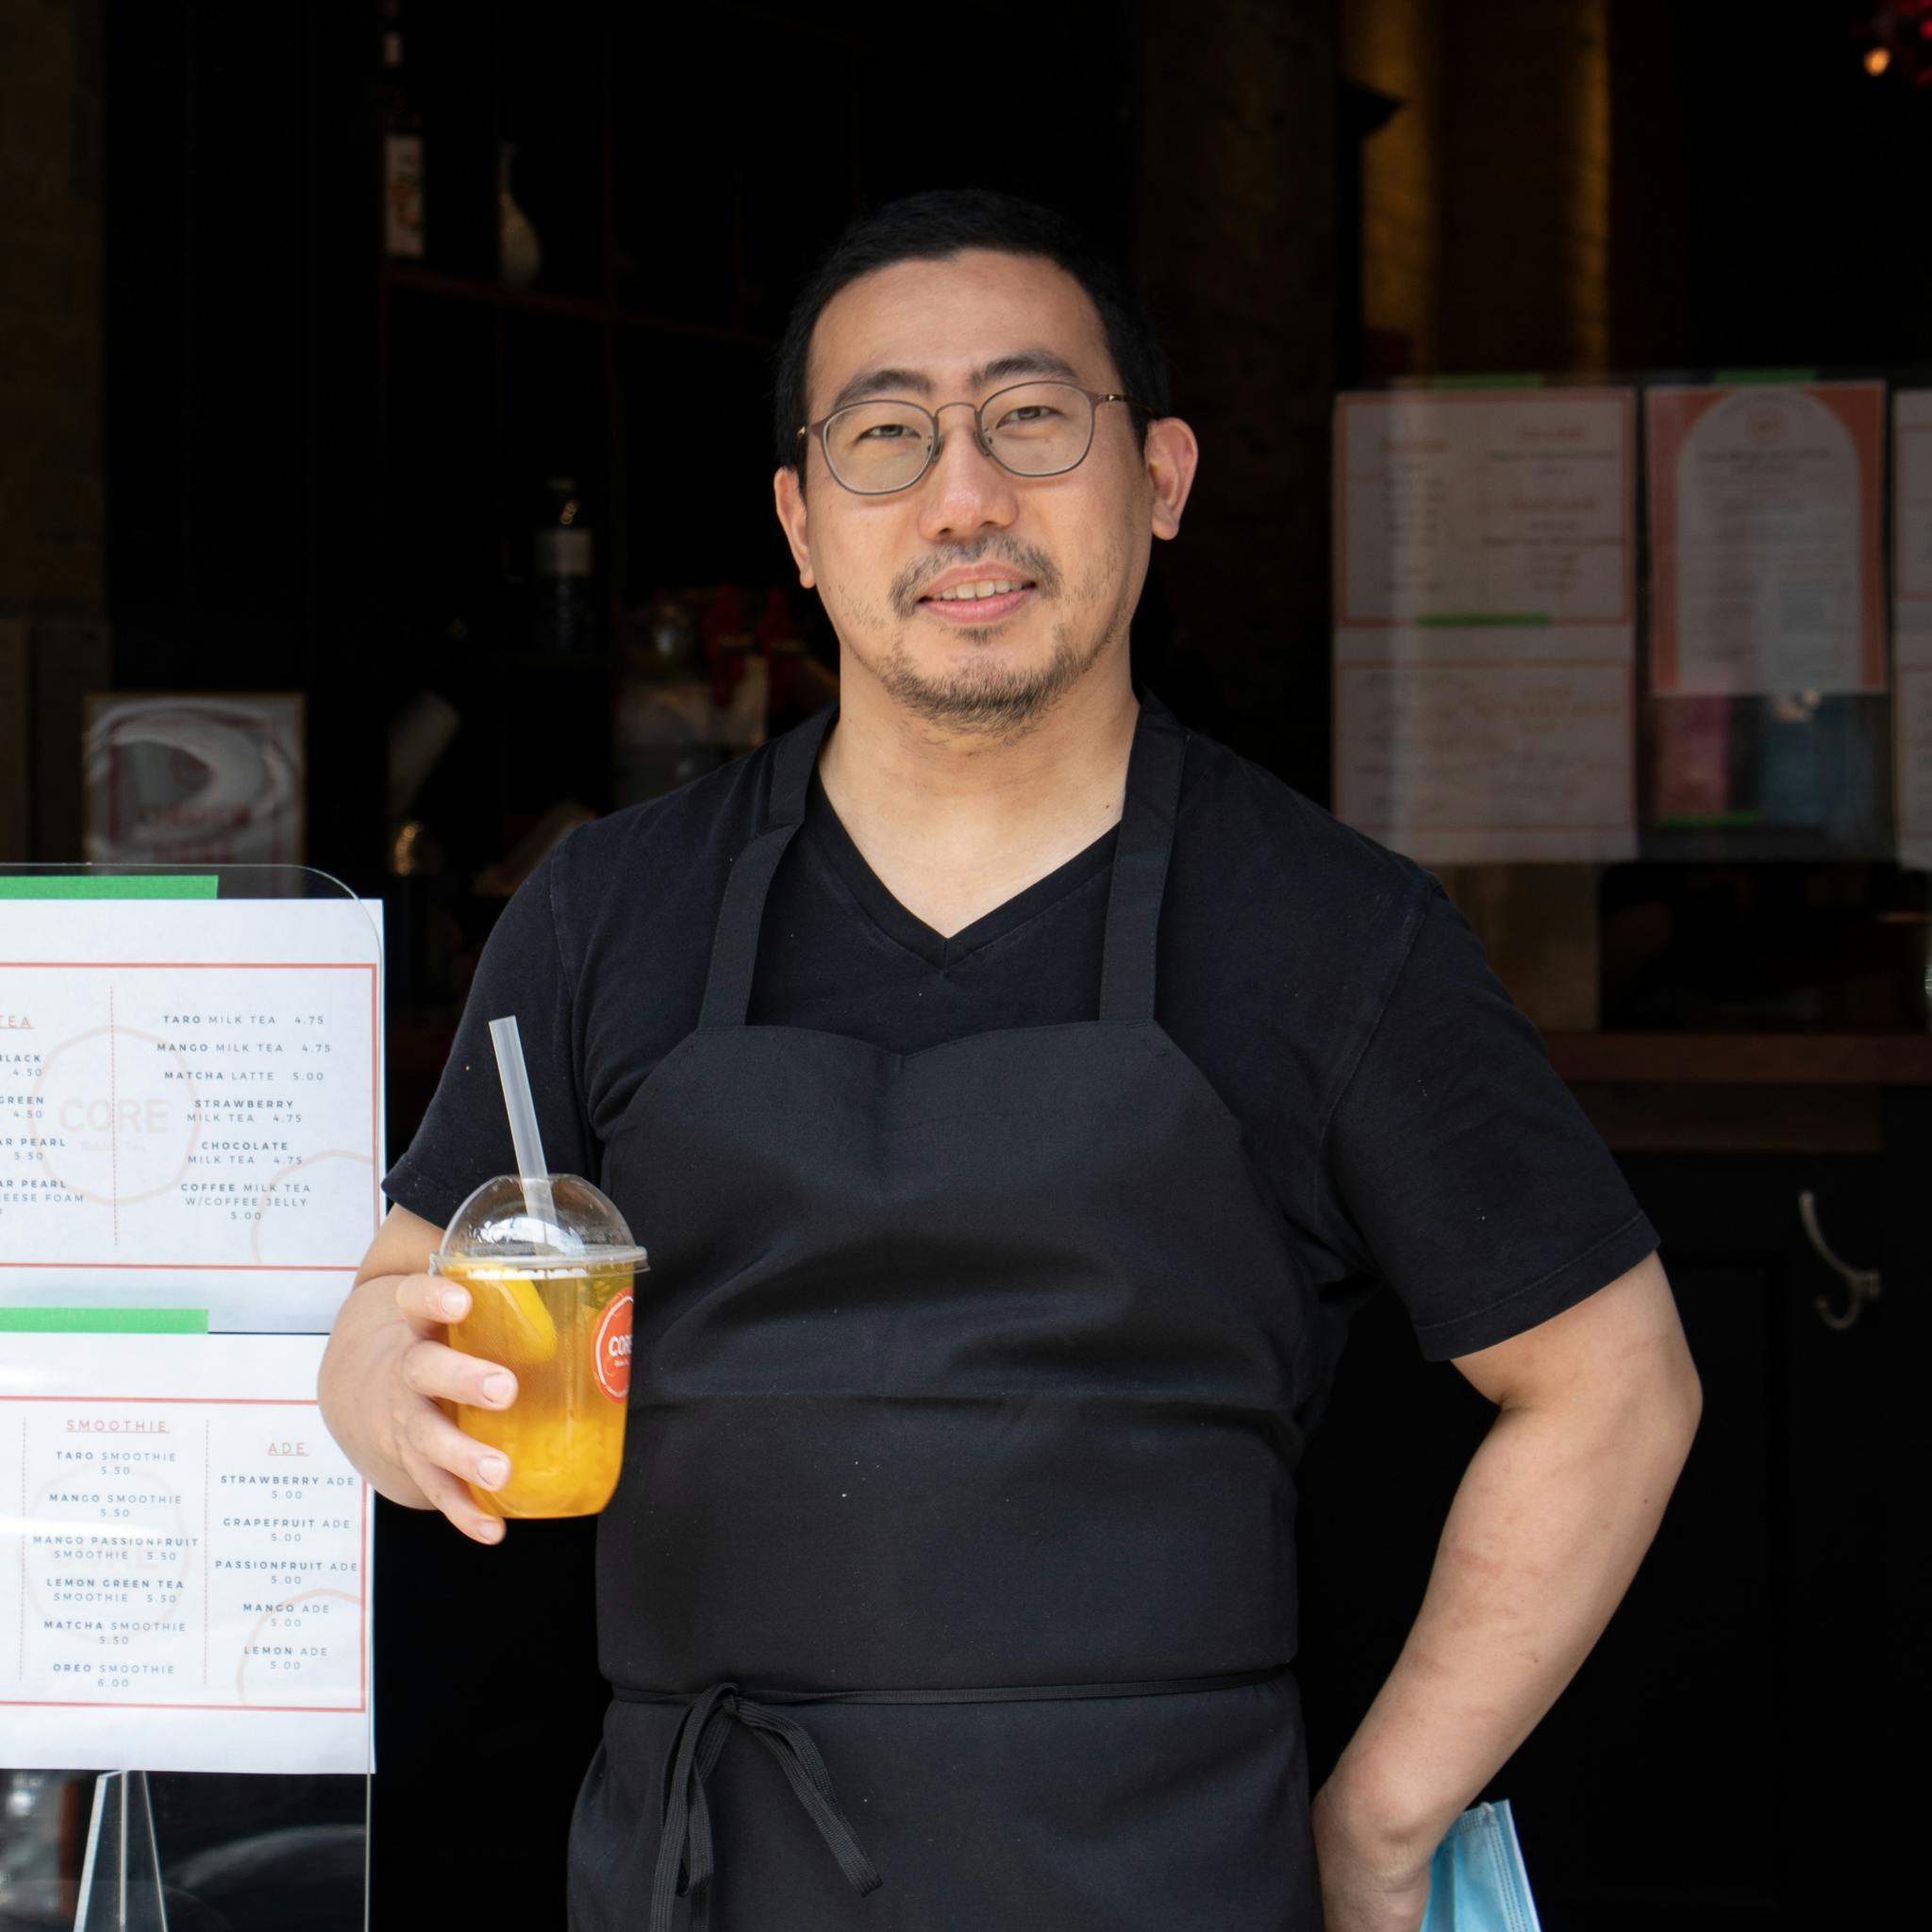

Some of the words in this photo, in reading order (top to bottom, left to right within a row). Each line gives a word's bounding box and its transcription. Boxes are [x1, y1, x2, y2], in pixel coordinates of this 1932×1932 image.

[163, 1015, 202, 1024] TARO
[208, 1016, 242, 1024] MILK
[250, 1016, 276, 1024] TEA
[294, 1016, 325, 1024] 4.75
[157, 1043, 208, 1052] MANGO
[215, 1043, 249, 1052] MILK
[258, 1044, 283, 1053] TEA
[301, 1044, 331, 1053] 4.75
[13, 1069, 42, 1077] 4.50
[164, 1071, 224, 1080] MATCHA
[231, 1072, 275, 1080] LATTE
[292, 1072, 325, 1081] 5.00
[194, 1100, 294, 1108] STRAWBERRY
[13, 1110, 43, 1119] 4.50
[273, 1114, 302, 1123] 4.75
[21, 1139, 66, 1147] PEARL
[202, 1141, 289, 1150] CHOCOLATE
[14, 1152, 43, 1160] 5.50
[188, 1156, 221, 1164] MILK
[274, 1157, 303, 1165] 4.75
[21, 1180, 67, 1189] PEARL
[180, 1183, 236, 1192] COFFEE
[242, 1184, 277, 1192] MILK
[285, 1184, 310, 1192] TEA
[0, 1193, 38, 1202] EESE
[45, 1193, 84, 1202] FOAM
[185, 1197, 258, 1207] W/COFFEE
[265, 1198, 308, 1207] JELLY
[230, 1211, 262, 1221] 5.00
[609, 1336, 632, 1357] COR
[66, 1420, 168, 1433] SMOOTHIE
[268, 1442, 306, 1456] ADE
[56, 1451, 93, 1461] TARO
[101, 1452, 176, 1462] SMOOTHIE
[101, 1466, 130, 1475] 5.50
[220, 1475, 320, 1485] STRAWBERRY
[326, 1477, 355, 1487] ADE
[48, 1493, 101, 1504] MANGO
[107, 1494, 182, 1505] SMOOTHIE
[272, 1491, 303, 1499] 5.00
[100, 1508, 129, 1518] 5.50
[223, 1518, 315, 1527] GRAPEFRUIT
[323, 1520, 350, 1529] ADE
[33, 1536, 84, 1545] MANGO
[92, 1537, 199, 1547] PASSIONFRUIT
[271, 1533, 302, 1542] 5.00
[53, 1550, 128, 1560] SMOOTHIE
[146, 1552, 176, 1561] 5.50
[215, 1560, 323, 1571] PASSIONFRUIT
[329, 1562, 358, 1572] ADE
[46, 1578, 96, 1588] LEMON
[102, 1579, 150, 1589] GREEN
[157, 1580, 184, 1589] TEA
[271, 1575, 302, 1585] 5.00
[53, 1592, 128, 1603] SMOOTHIE
[146, 1594, 176, 1604] 5.50
[243, 1604, 294, 1613] MANGO
[302, 1605, 330, 1614] ADE
[43, 1621, 104, 1630] MATCHA
[110, 1622, 186, 1632] SMOOTHIE
[271, 1618, 302, 1627] 5.00
[99, 1636, 128, 1645] 5.50
[243, 1646, 293, 1656] LEMON
[300, 1648, 327, 1657] ADE
[53, 1663, 92, 1673] OREO
[99, 1664, 175, 1674] SMOOTHIE
[270, 1661, 301, 1670] 5.00
[97, 1678, 129, 1688] 6.00
